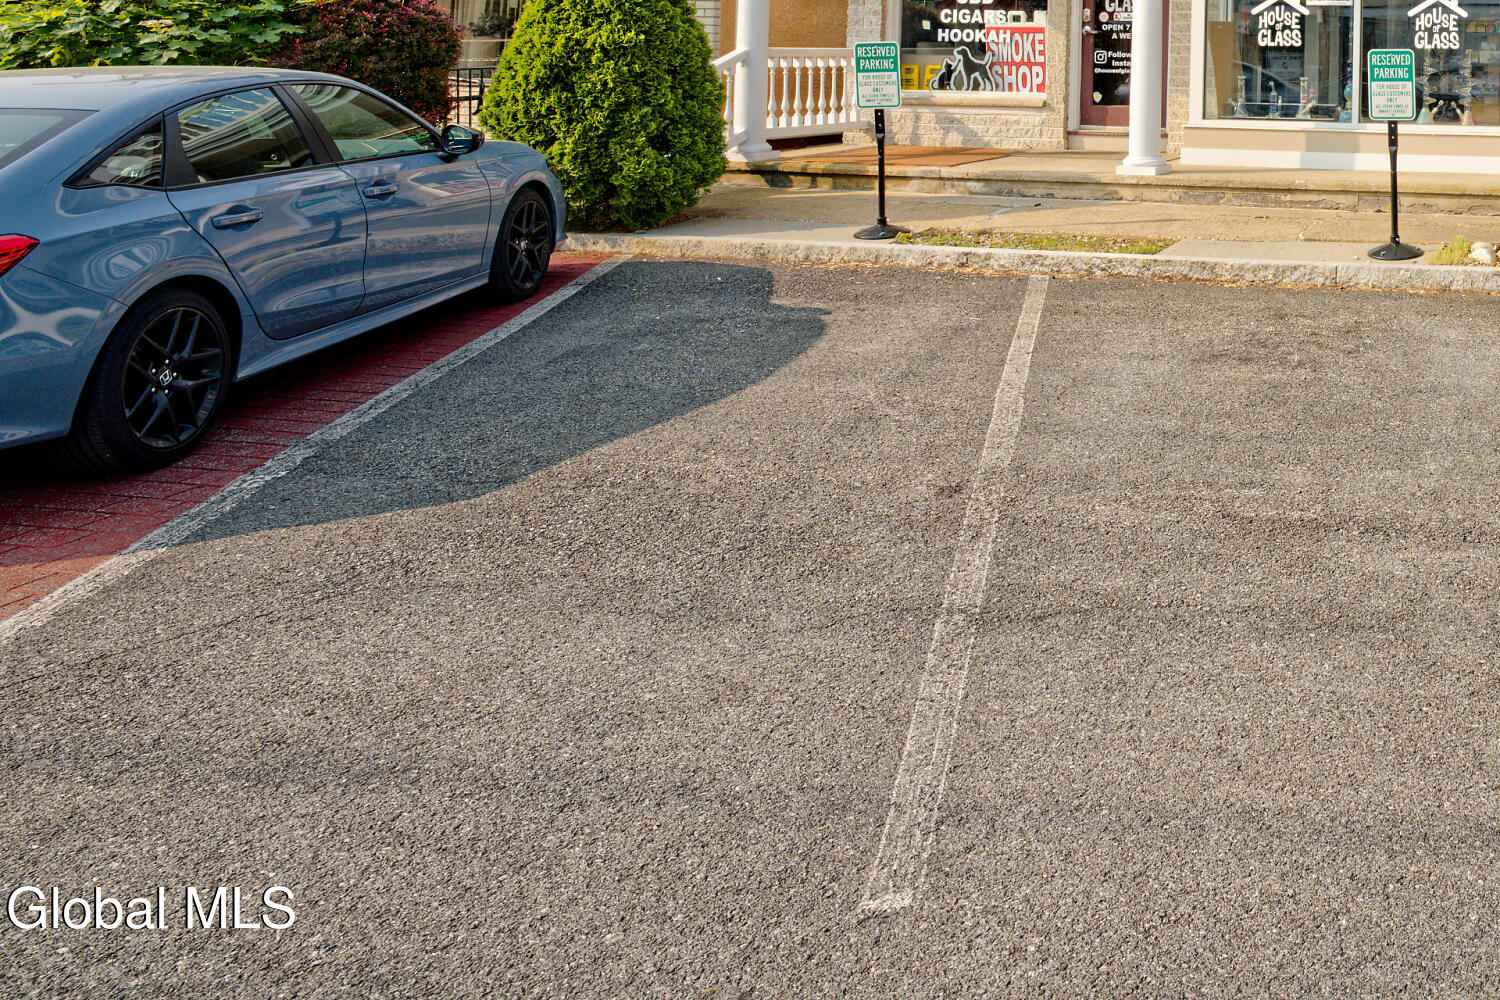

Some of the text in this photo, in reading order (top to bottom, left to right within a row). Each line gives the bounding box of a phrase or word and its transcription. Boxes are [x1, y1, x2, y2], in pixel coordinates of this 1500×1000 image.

[940, 9, 1007, 24] CIGARS
[1258, 5, 1301, 29] HOUSE
[1415, 6, 1459, 31] HOUSE
[1102, 23, 1124, 31] OPEN
[937, 28, 1011, 43] HOOKAH
[1257, 29, 1302, 47] GLASS
[1414, 31, 1460, 49] GLASS
[857, 46, 896, 57] RESERVED
[988, 31, 1045, 63] SMOKE
[860, 58, 894, 70] PARKING
[1371, 54, 1411, 66] RESERVED
[991, 64, 1044, 92] SHOP
[1374, 67, 1409, 79] PARKING
